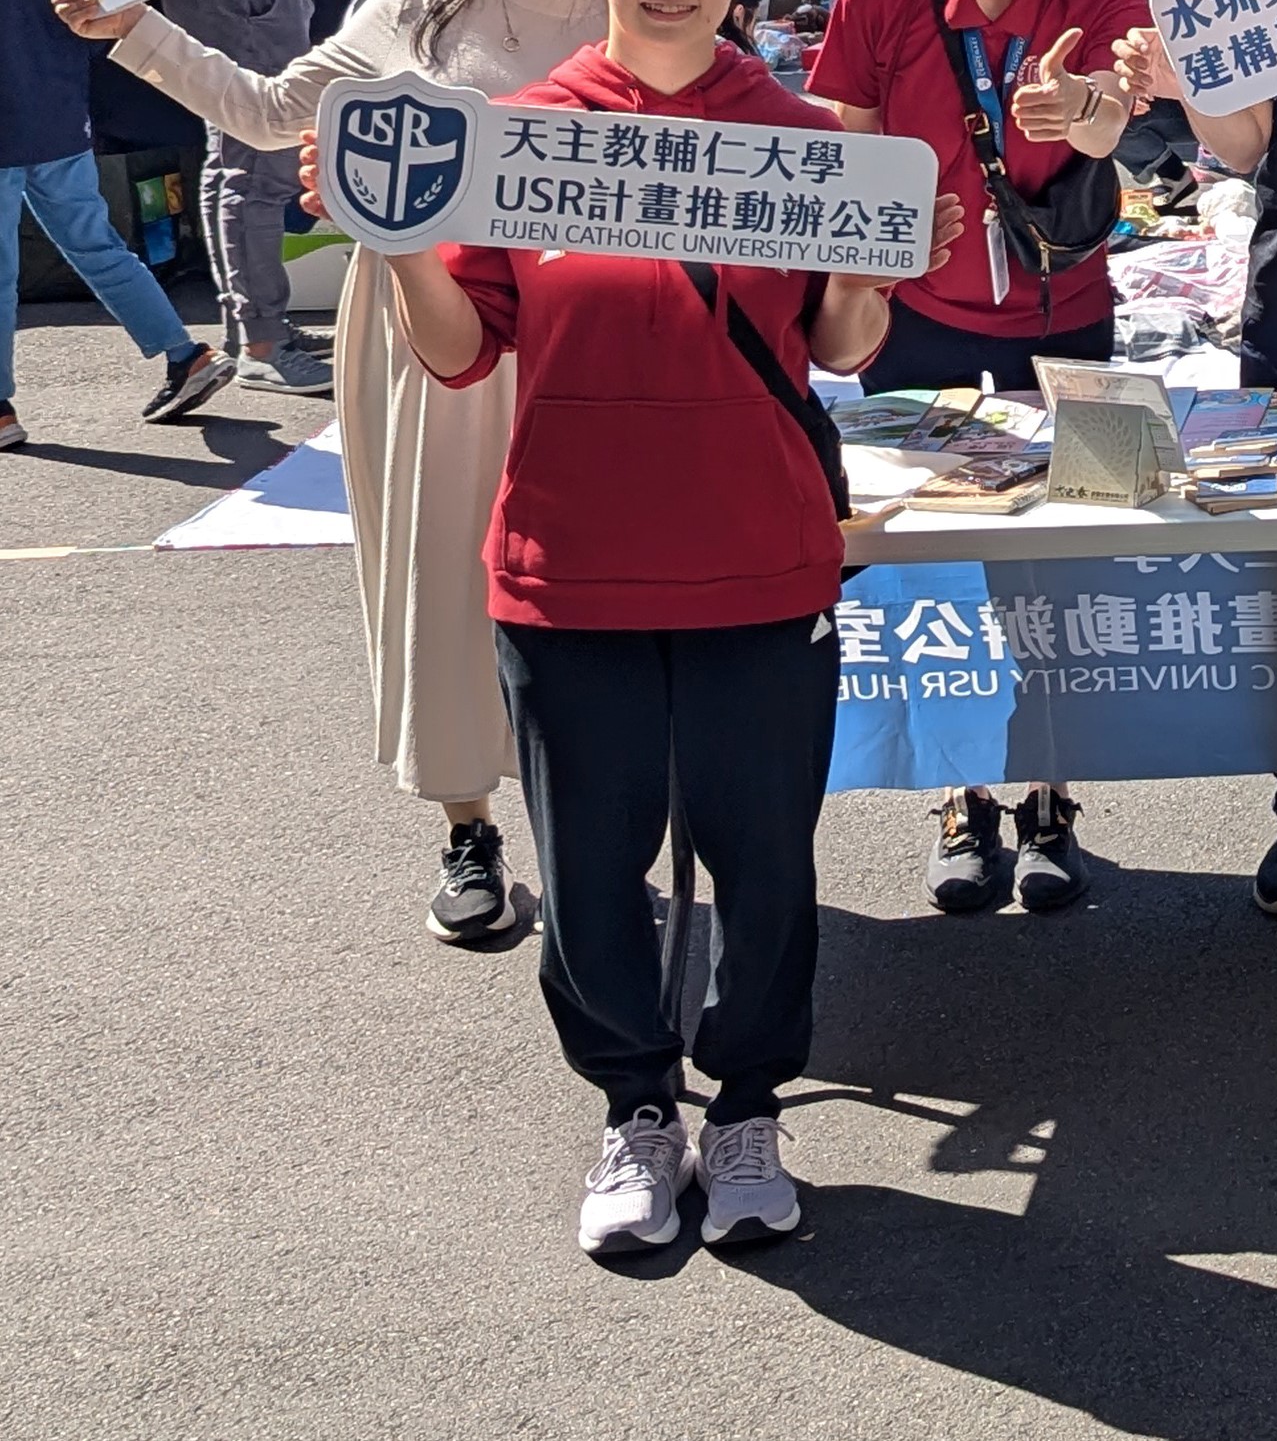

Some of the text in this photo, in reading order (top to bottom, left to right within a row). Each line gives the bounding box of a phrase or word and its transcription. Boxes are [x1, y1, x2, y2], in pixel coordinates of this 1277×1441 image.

[347, 105, 434, 148] USR
[500, 117, 845, 184] 天主教輔仁大學
[495, 174, 919, 245] USR計畫推動辦公室
[490, 219, 914, 269] FUJEN CATHOLIC UNIVERSITY USR-HUB
